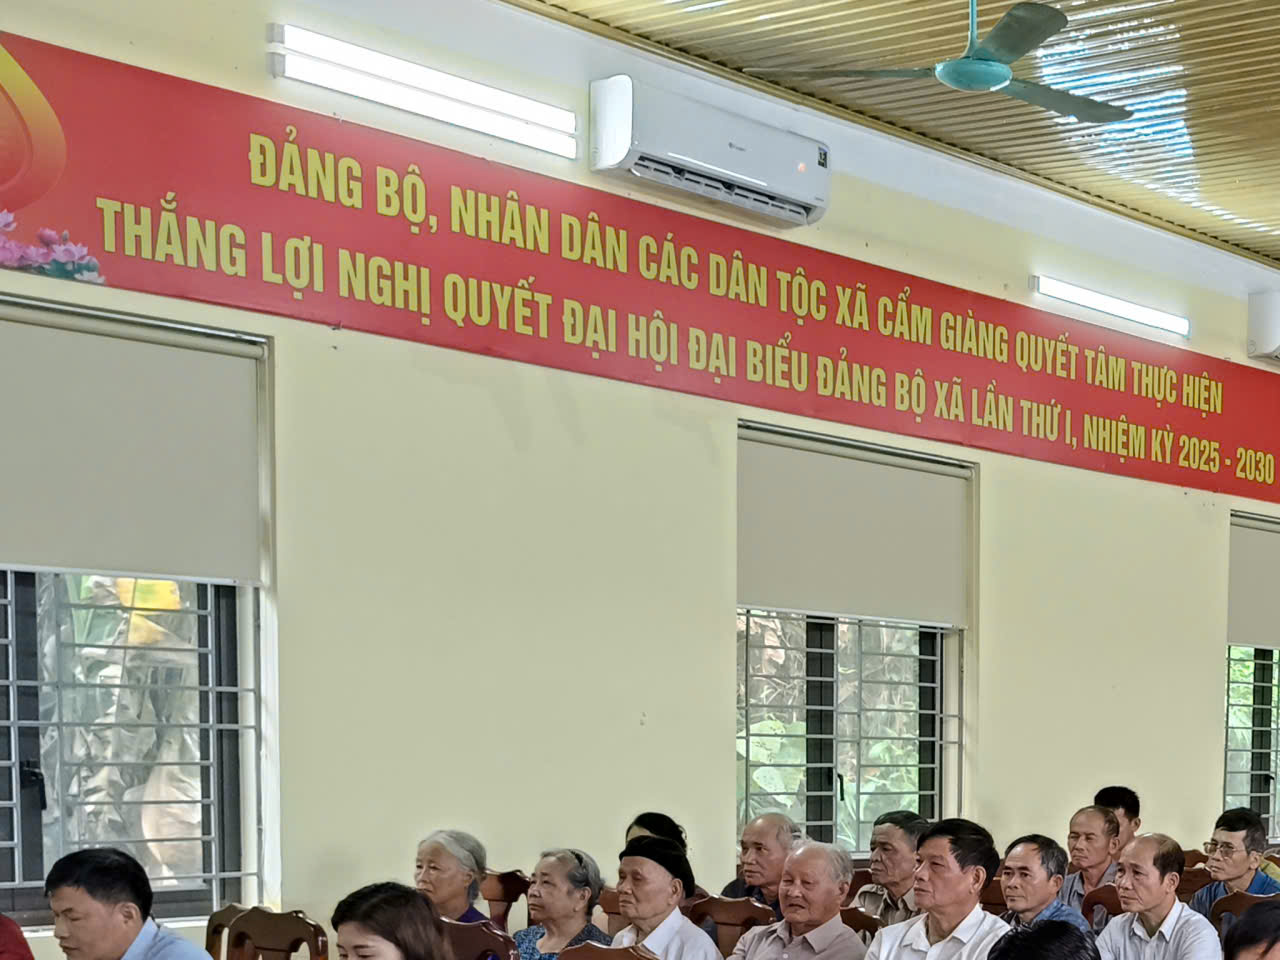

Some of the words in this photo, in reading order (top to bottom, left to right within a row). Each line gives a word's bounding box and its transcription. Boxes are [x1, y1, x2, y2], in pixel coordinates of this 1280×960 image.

[96, 191, 247, 278] THẮNG
[261, 231, 325, 300] LỢI
[338, 248, 431, 326] NGHỊ
[443, 276, 553, 339] QUYẾT
[562, 299, 617, 360] ĐẠI
[627, 310, 678, 373] HỘI
[687, 327, 737, 384] ĐẠI
[746, 331, 809, 392] BIỂU
[817, 347, 887, 408] ĐẢNG
[895, 368, 926, 423] BỘ
[933, 376, 965, 423] XÃ
[971, 379, 1014, 433] LẦN
[1019, 398, 1062, 442] THỨ
[1064, 410, 1077, 450] I,
[1083, 414, 1146, 463] NHIỆM
[1150, 424, 1175, 465] KỲ
[1178, 435, 1220, 474] 2025
[1236, 447, 1275, 485] 2030
[248, 125, 363, 209] ĐẢNG
[376, 164, 438, 234] BỘ,
[450, 189, 550, 254] NHÂN
[561, 212, 628, 273] DÂN
[638, 232, 699, 290] CÁC
[709, 250, 768, 308] DÂN
[776, 267, 827, 326] TỘC
[835, 282, 870, 331] XÃ
[877, 286, 933, 345] CẨM
[940, 309, 1009, 363] GIÀNG
[1015, 331, 1079, 381] QUYẾT
[1084, 345, 1126, 392] TÂM
[1131, 360, 1177, 408] THỰC
[1182, 371, 1223, 418] HIỆN
